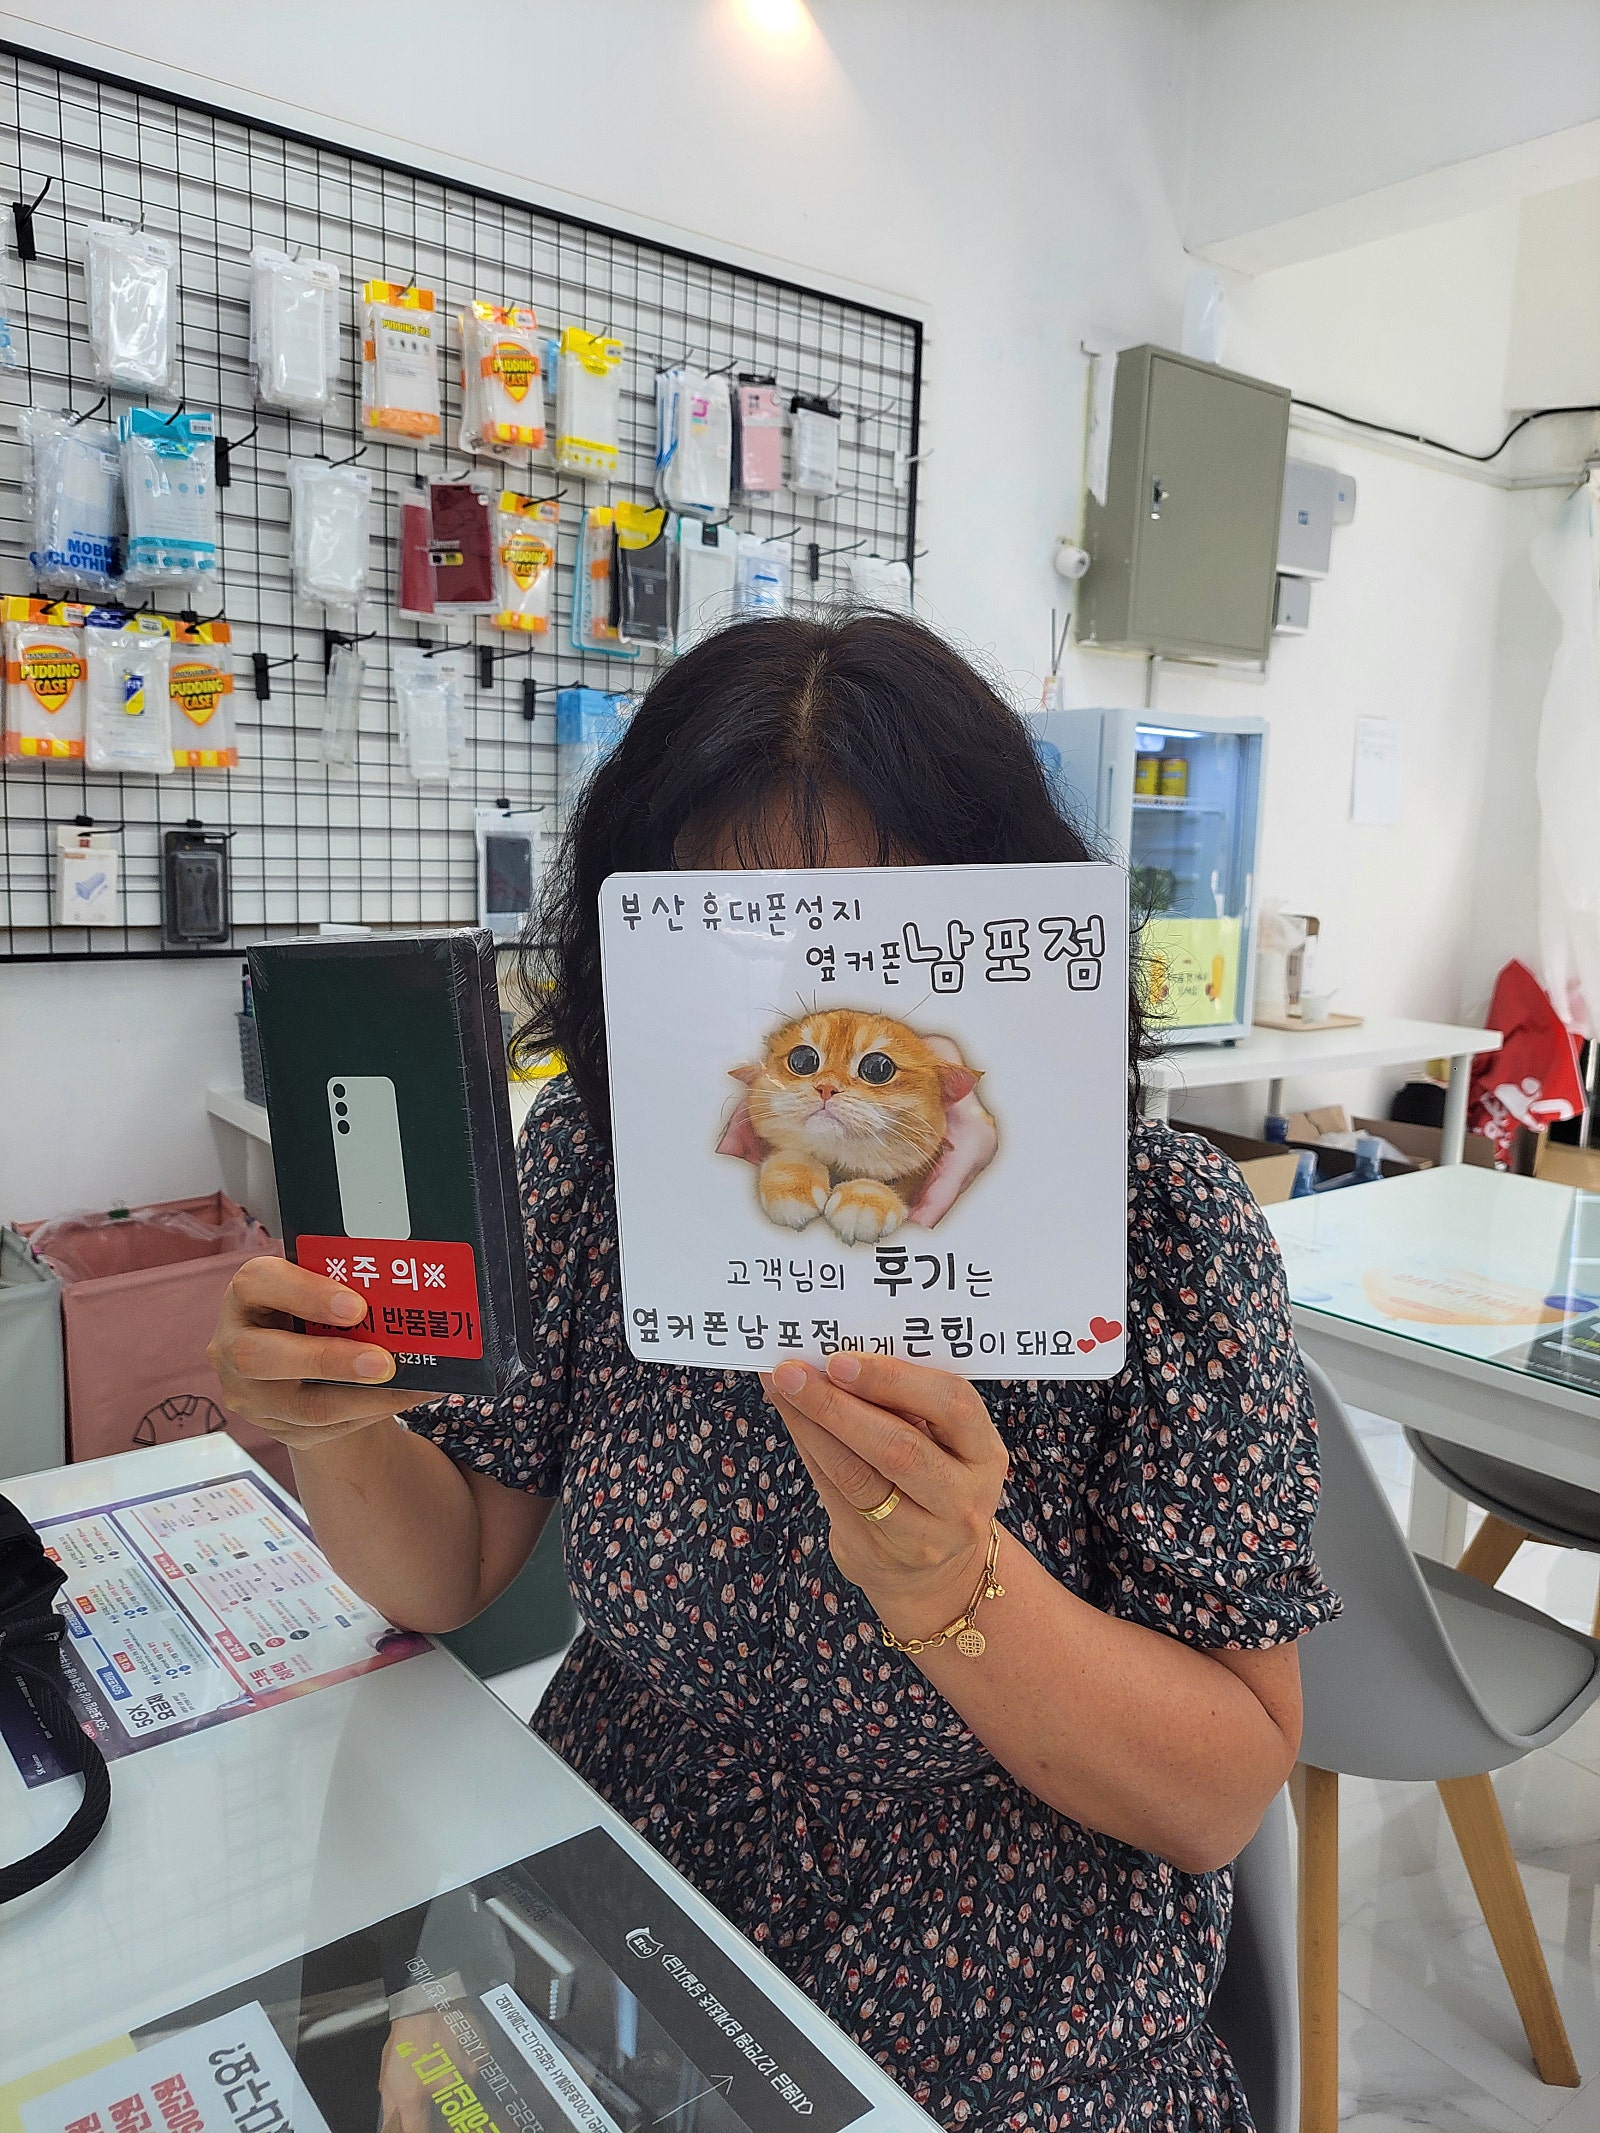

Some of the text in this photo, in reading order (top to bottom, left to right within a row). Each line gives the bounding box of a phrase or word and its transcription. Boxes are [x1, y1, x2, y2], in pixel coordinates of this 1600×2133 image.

[493, 359, 536, 373] PUDDING
[504, 549, 548, 563] PUDDING
[21, 663, 80, 681] PUDDING
[35, 679, 67, 695] CASE
[169, 679, 224, 697] PUDDING
[184, 695, 213, 711] CASE
[621, 892, 861, 936] 부산 휴대폰성지
[727, 1246, 994, 1298] 고객님의 후기는
[383, 1307, 473, 1340] 반품불가
[1017, 1329, 1076, 1358] 돼요
[399, 1352, 437, 1366] S23 FE
[249, 1667, 275, 1688] 구독
[269, 1659, 295, 1681] 혜택
[125, 1703, 154, 1729] 5GX
[145, 1691, 177, 1723] 요금제
[93, 1717, 110, 1731] 5GX
[36, 1767, 46, 1777] SK
[698, 1991, 743, 2038] 업계최초
[442, 2009, 486, 2056] 지원금을
[520, 2030, 559, 2073] 직접보시고
[733, 2030, 779, 2077] 127만원
[548, 2069, 595, 2120] 200호점에서
